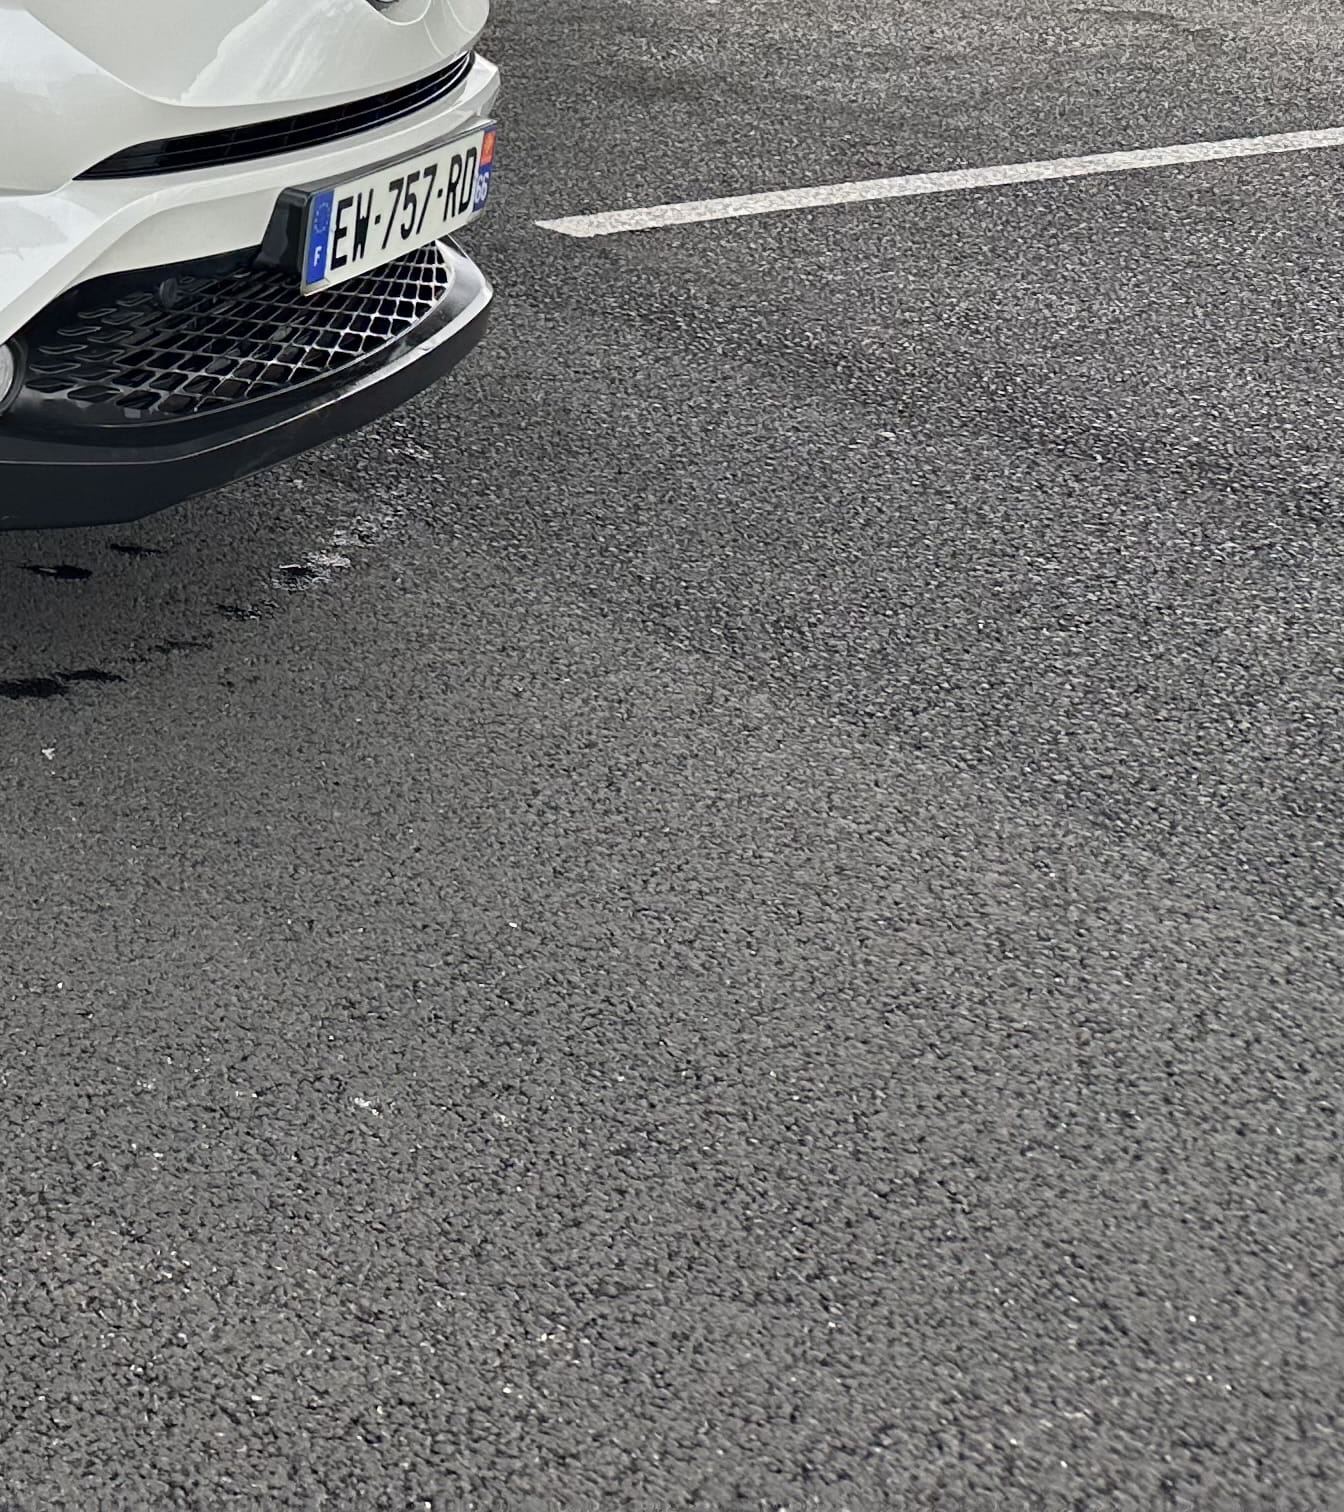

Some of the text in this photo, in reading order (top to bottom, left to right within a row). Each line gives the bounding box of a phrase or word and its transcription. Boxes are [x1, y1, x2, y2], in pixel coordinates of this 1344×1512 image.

[473, 171, 490, 204] 66
[330, 146, 478, 271] EW-757-RD
[313, 246, 322, 267] F
